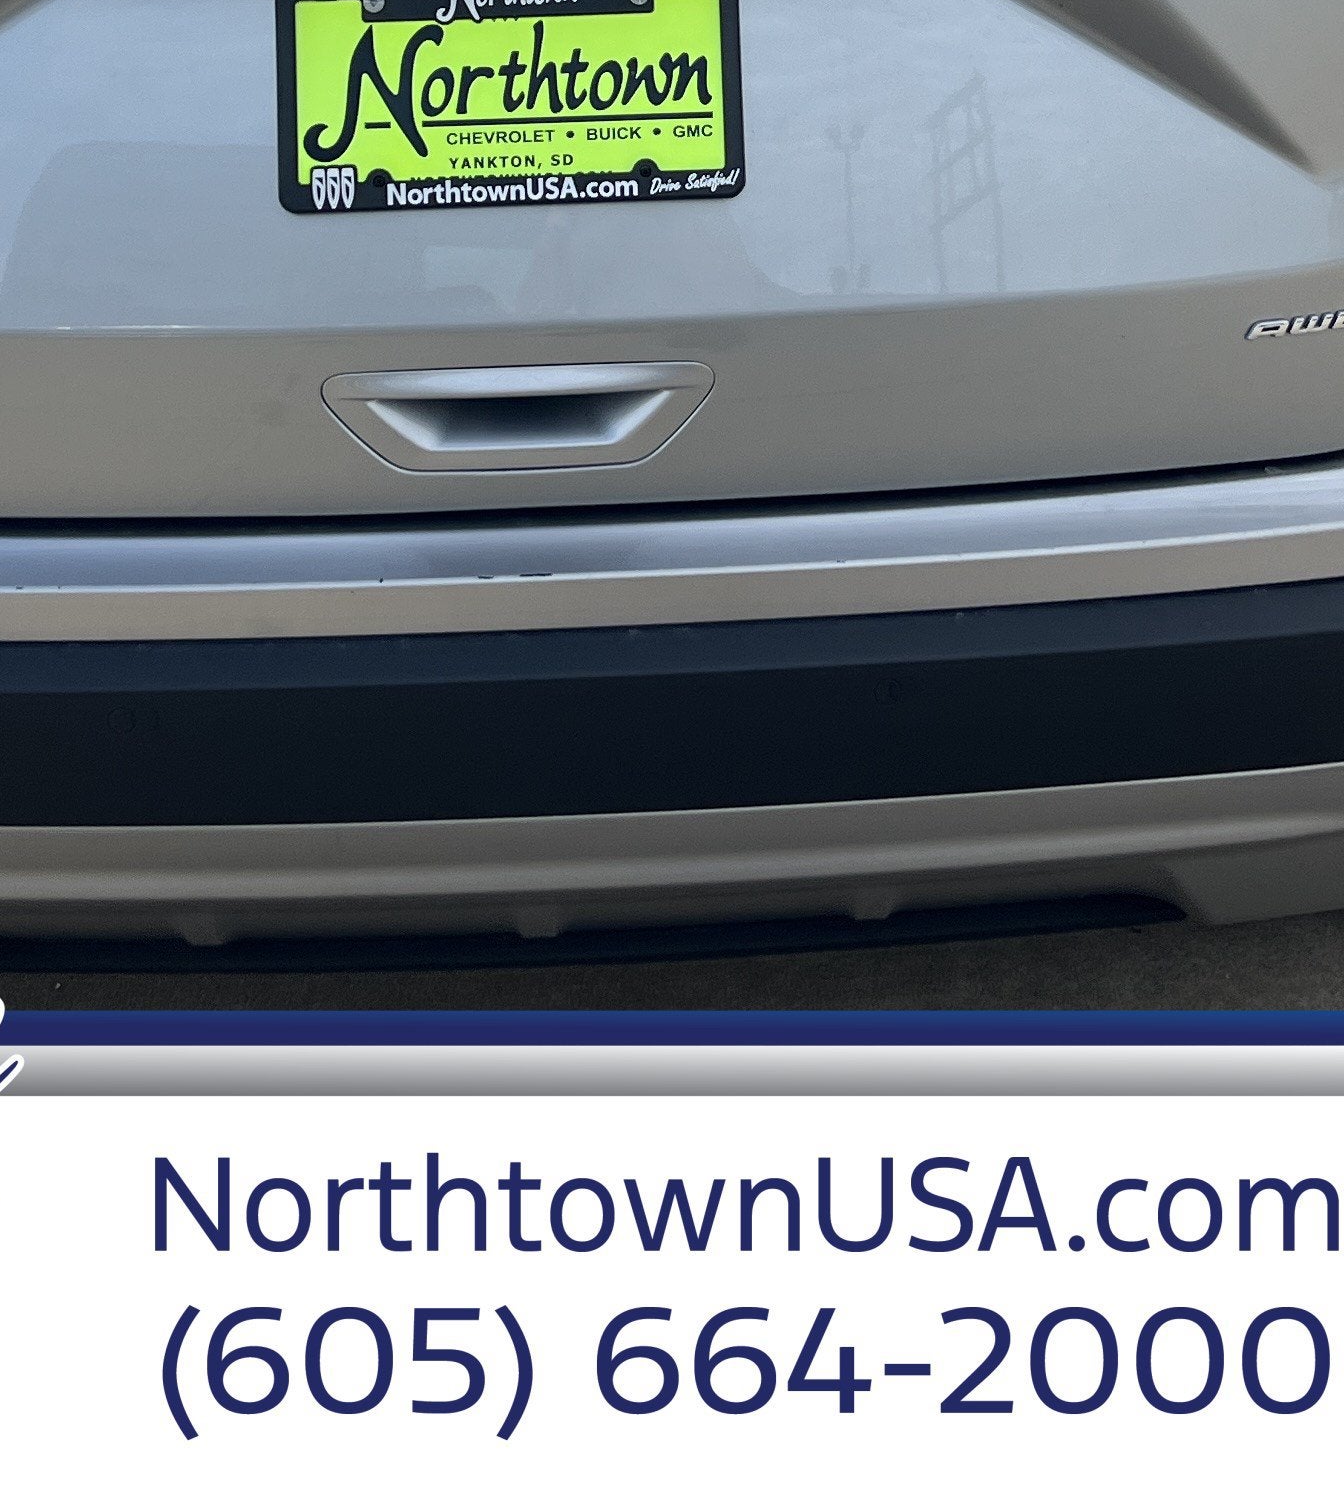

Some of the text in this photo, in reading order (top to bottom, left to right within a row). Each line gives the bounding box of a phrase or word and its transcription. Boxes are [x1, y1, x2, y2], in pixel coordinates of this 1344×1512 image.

[302, 20, 713, 163] Northtown
[446, 124, 714, 146] CHEVROLET BUICK GMC
[448, 152, 575, 170] YANKTON, SD
[386, 179, 639, 207] NorthtownUSA.com
[649, 177, 682, 196] Drive
